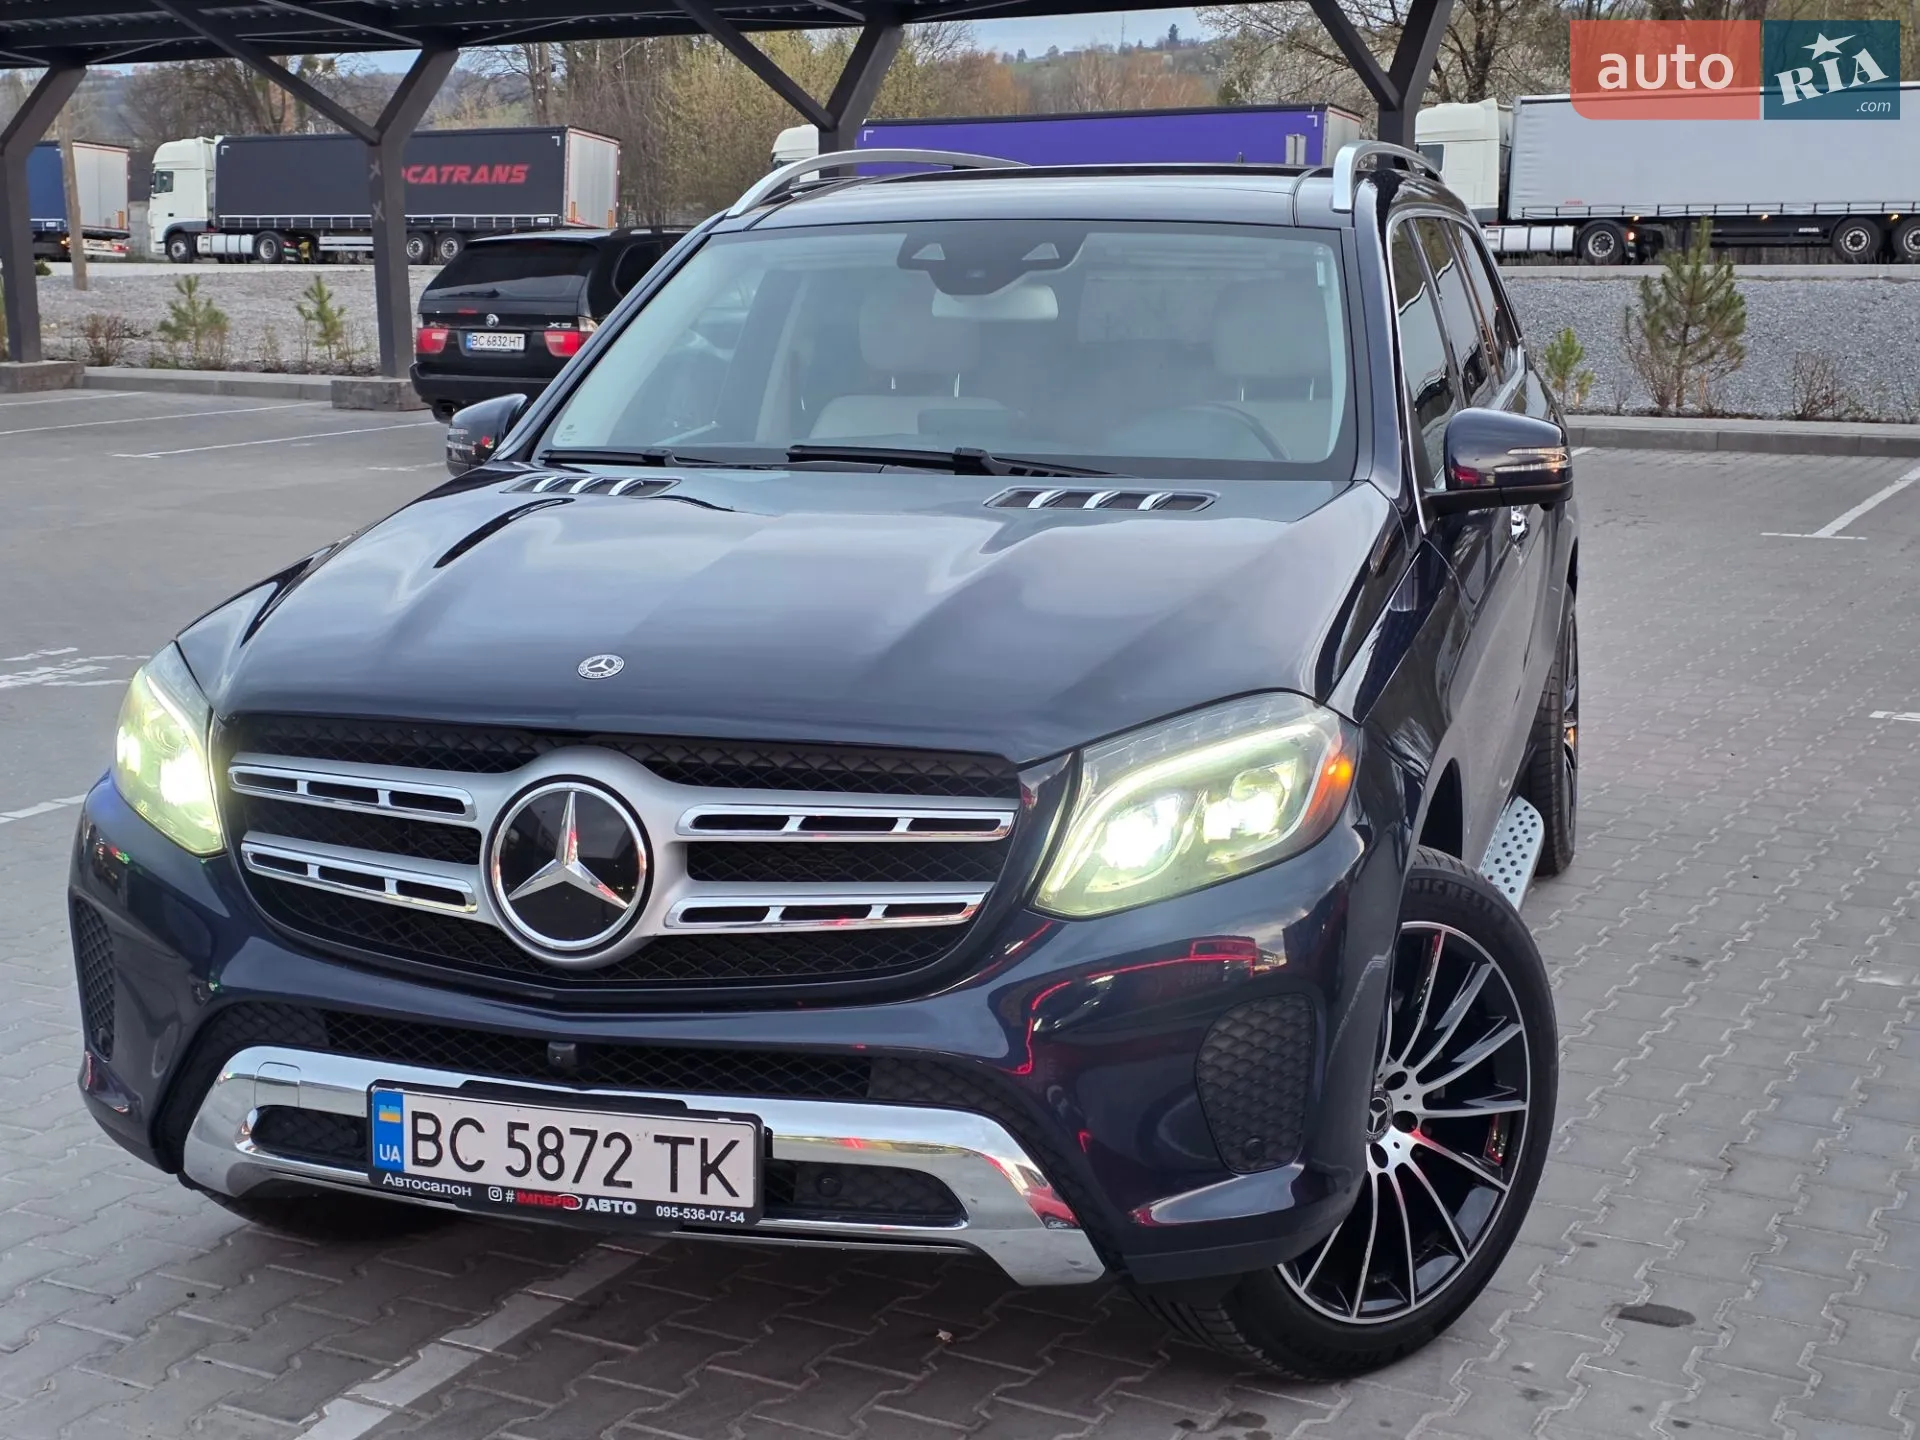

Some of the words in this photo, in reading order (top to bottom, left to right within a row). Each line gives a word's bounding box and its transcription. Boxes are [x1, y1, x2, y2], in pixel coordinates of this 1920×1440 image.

[401, 164, 530, 184] CATRANS
[471, 335, 484, 347] BC
[486, 333, 507, 347] 6832
[509, 336, 522, 348] HT
[379, 1143, 401, 1163] UA
[411, 1110, 486, 1173] BC
[505, 1121, 633, 1189] 5872
[653, 1134, 740, 1198] TK
[382, 1172, 473, 1197] Автосалон
[585, 1198, 637, 1215] АВТО
[656, 1205, 746, 1224] 095-536-07-54
